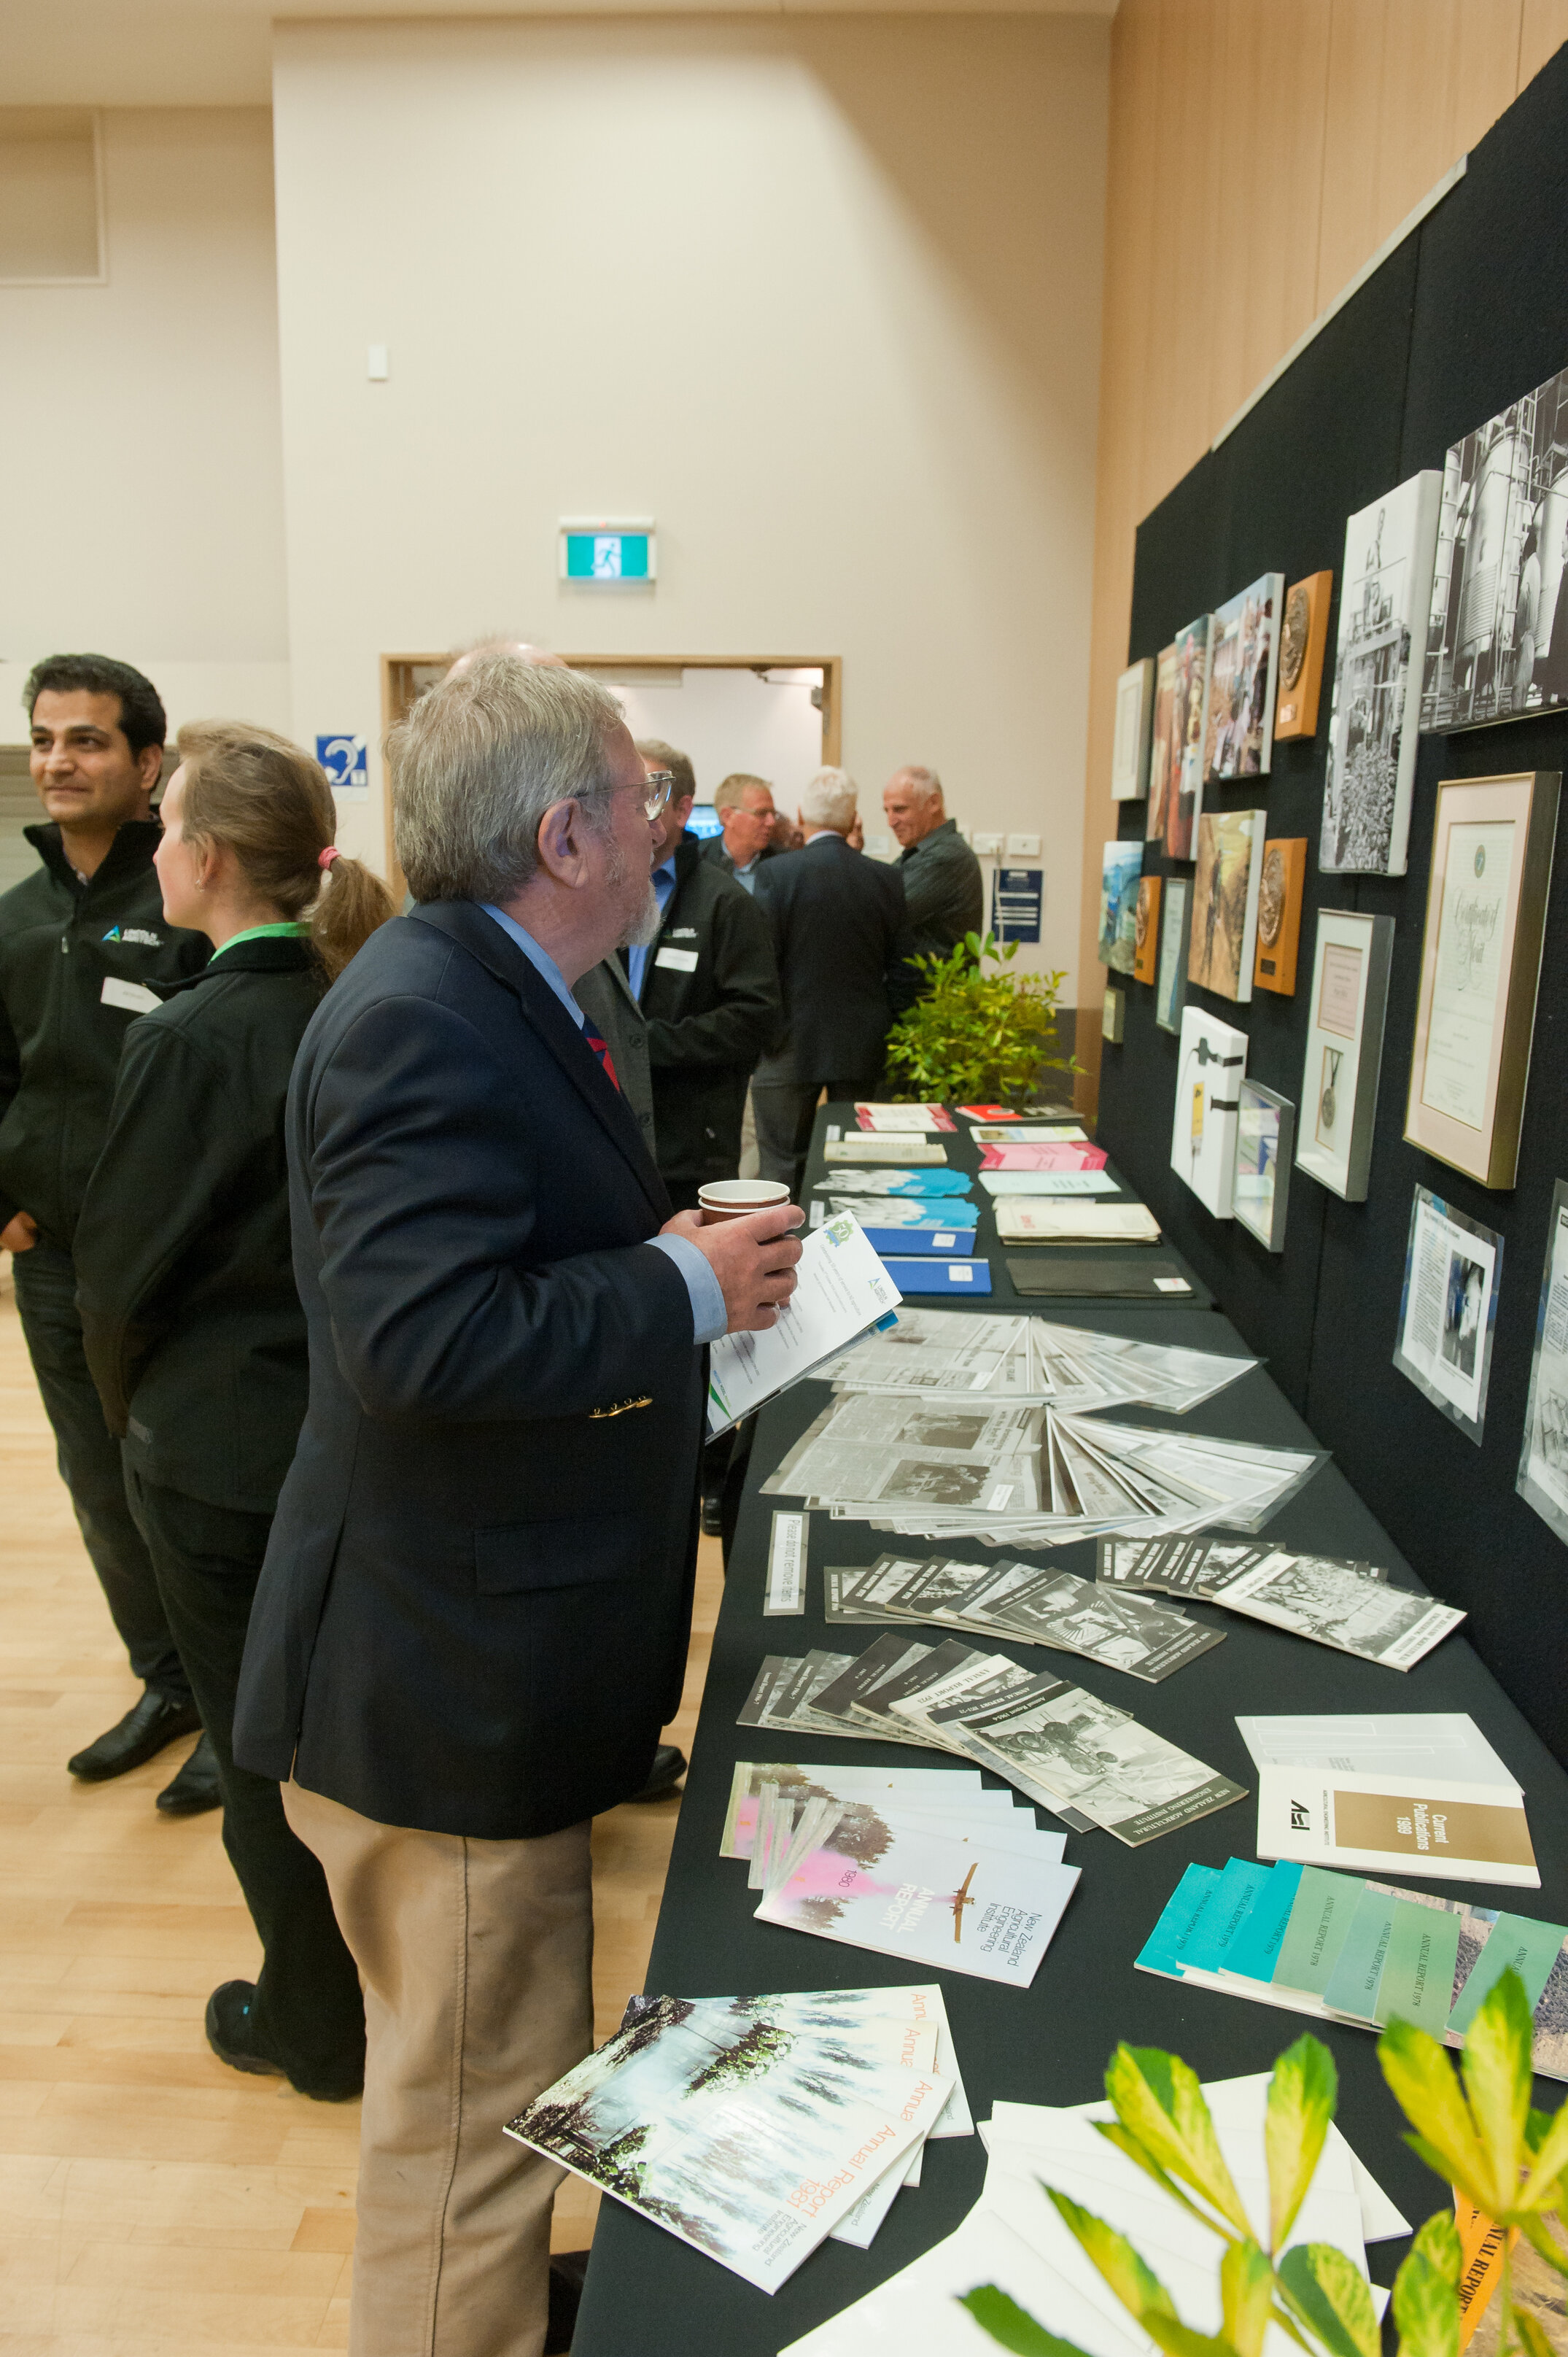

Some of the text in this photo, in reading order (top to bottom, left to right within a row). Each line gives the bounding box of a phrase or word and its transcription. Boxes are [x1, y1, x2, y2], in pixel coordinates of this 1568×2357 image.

[832, 1223, 849, 1239] 50
[786, 1520, 801, 1539] Please
[785, 1547, 798, 1558] not
[783, 1559, 794, 1585] remove
[780, 1586, 796, 1603] items
[934, 1682, 962, 1697] REPORT
[963, 1668, 991, 1684] ANNUAL
[1004, 1687, 1031, 1700] ANNUAL
[1133, 1787, 1212, 1825] ENGINEERING INSTITUTE
[1133, 1788, 1231, 1835] NEW ZEALAND AGRICULTURAL
[1397, 1816, 1413, 1835] 1989
[1413, 1803, 1429, 1851] Publications
[1432, 1814, 1449, 1844] Current
[839, 1870, 857, 1888] 1980
[878, 1883, 918, 1930] REPORT
[896, 1886, 935, 1934] ANNUAL
[977, 1903, 1001, 1932] Institute
[1198, 1889, 1213, 1913] ANNUAL
[1218, 1884, 1255, 1948] ANNUAL REPORT 1979
[980, 1905, 1015, 1952] Engineering
[998, 1908, 1028, 1953] Agricultural
[1006, 1912, 1042, 1967] New Zealand
[1176, 1936, 1189, 1950] 1979
[1264, 1940, 1276, 1954] 1979
[1275, 1916, 1290, 1943] REPORT
[1310, 1895, 1335, 1966] ANNUAL REPORT 1978
[1365, 1921, 1392, 1991] ANNUAL REPORT 1978
[1412, 1933, 1431, 2007] ANNUAL REPORT 1978
[901, 2028, 921, 2067] Annua
[901, 2080, 933, 2121] Annua
[801, 2124, 896, 2218] Annual Report
[786, 2178, 820, 2209] 1981
[752, 2214, 791, 2251] Engineering
[763, 2218, 798, 2255] Agricultural
[764, 2224, 807, 2267] New Zealand
[1459, 2223, 1507, 2313] NUAL REPORT
